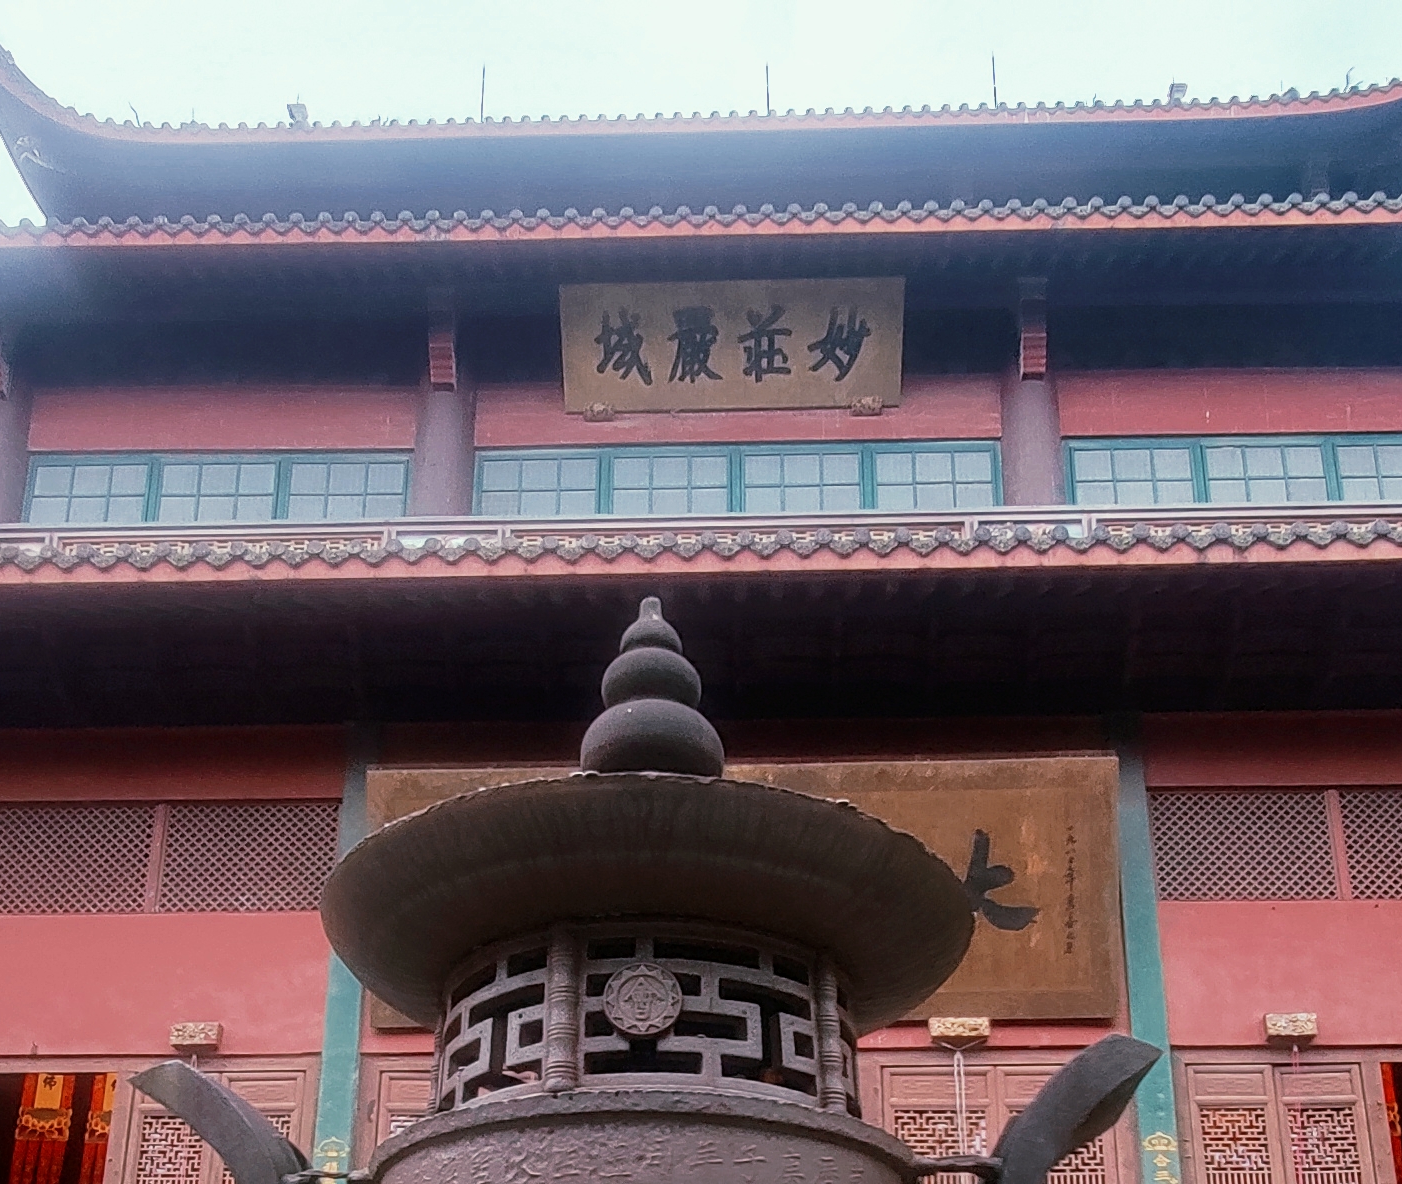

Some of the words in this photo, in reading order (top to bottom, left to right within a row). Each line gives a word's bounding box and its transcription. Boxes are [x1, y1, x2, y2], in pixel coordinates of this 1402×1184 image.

[593, 303, 872, 387] 妙莊嚴域
[42, 1075, 58, 1091] 佛
